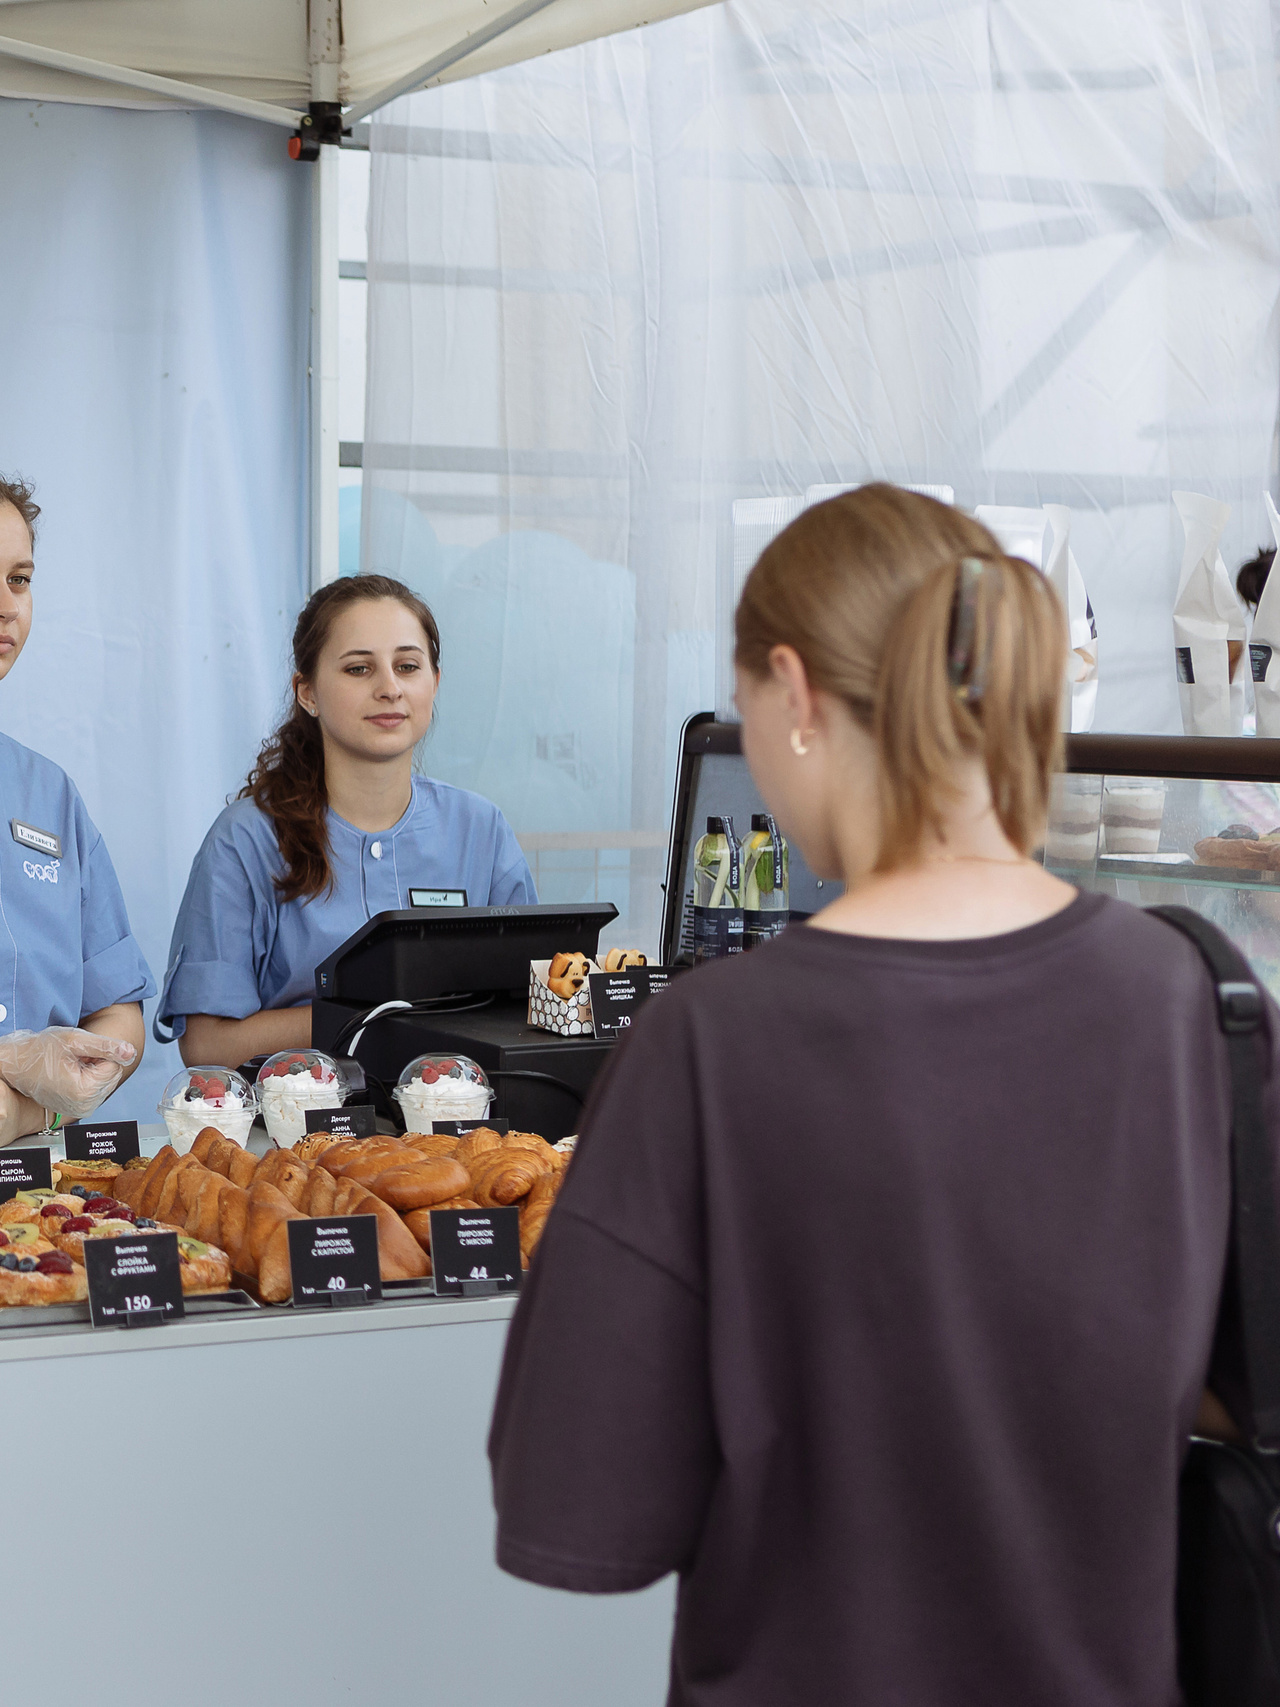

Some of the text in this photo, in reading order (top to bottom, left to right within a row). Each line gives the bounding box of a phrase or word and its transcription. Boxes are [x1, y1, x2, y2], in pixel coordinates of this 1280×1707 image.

[606, 986, 636, 995] ТВОРОЖНЫЙ
[618, 1016, 631, 1027] 70
[86, 1131, 118, 1139] Пирожные
[89, 1146, 117, 1155] ЯГОДНЫЙ
[1, 1168, 25, 1176] СЫРОМ
[459, 1218, 491, 1226] Выпечка
[316, 1227, 348, 1236] Выпечка
[457, 1230, 495, 1238] ПИРОЖОК
[314, 1238, 352, 1248] ПИРОЖОК
[460, 1238, 493, 1246] С МЯСОМ
[115, 1245, 148, 1255] Выпечка
[311, 1246, 355, 1256] С КАПУСТОЙ
[117, 1256, 149, 1267] СЛОЙКА
[111, 1264, 157, 1276] С ФРУКТАМИ
[470, 1266, 489, 1280] 44
[328, 1276, 346, 1290] 40
[125, 1295, 152, 1311] 150
